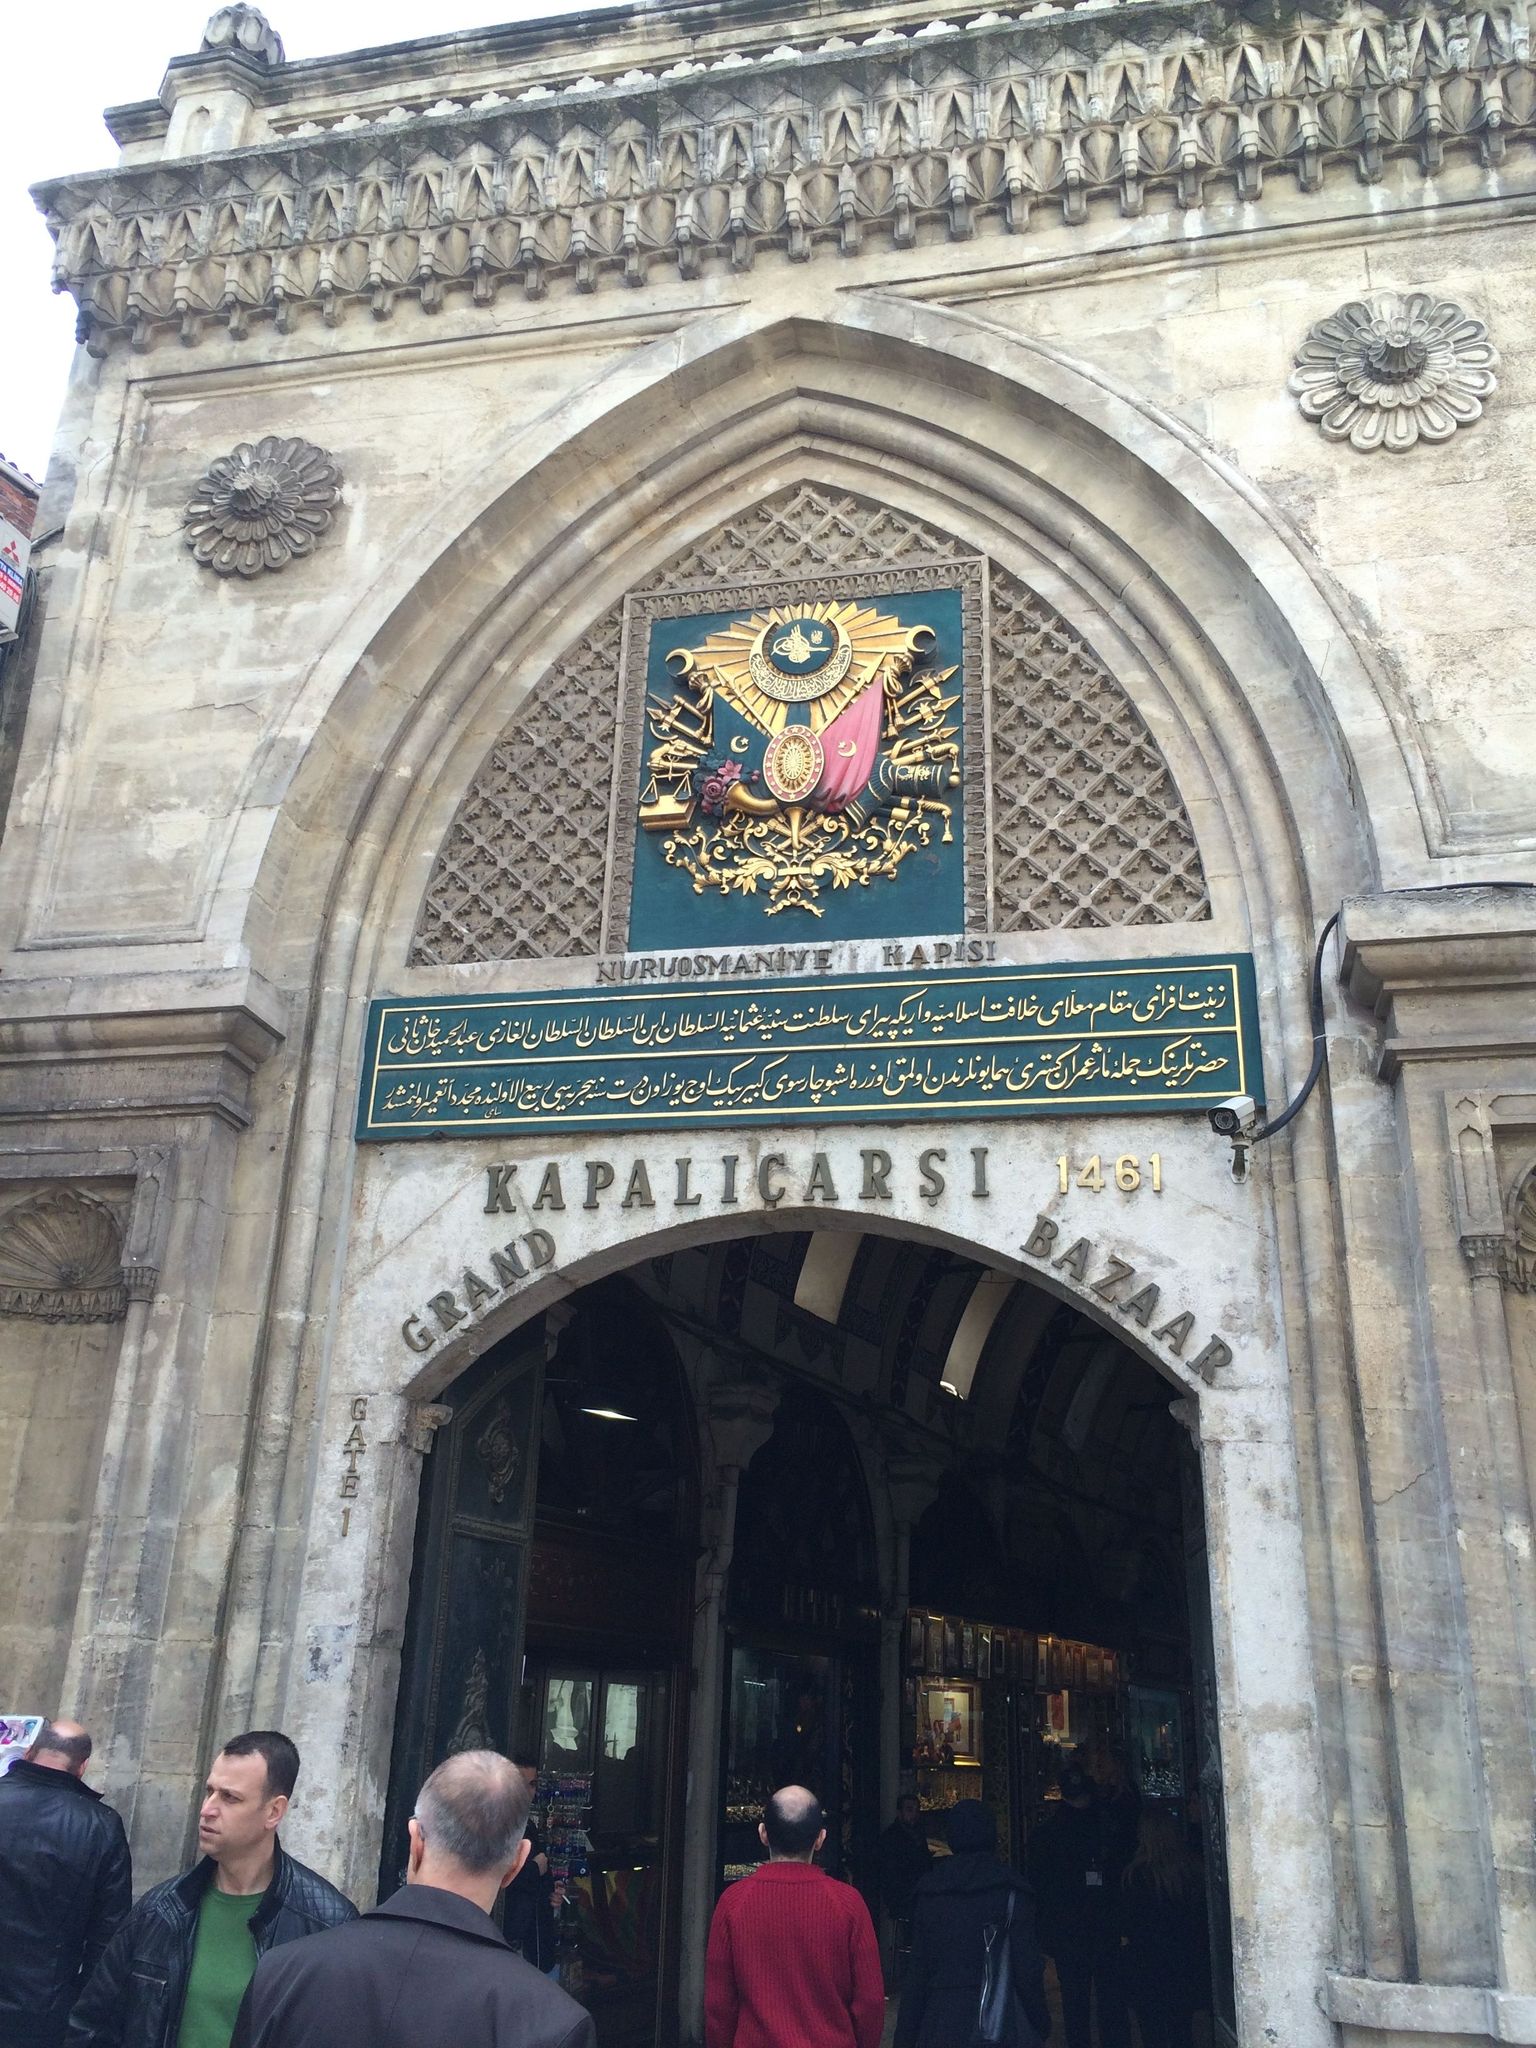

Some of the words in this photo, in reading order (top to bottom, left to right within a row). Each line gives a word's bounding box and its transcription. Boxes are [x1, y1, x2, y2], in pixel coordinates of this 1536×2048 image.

[597, 946, 833, 982] NURUOSMANİYE
[883, 940, 996, 966] KAPISI
[1056, 1153, 1162, 1194] 1461
[402, 1228, 556, 1352] GRAND
[1020, 1214, 1233, 1384] BAZAAR
[340, 1397, 368, 1498] GATE
